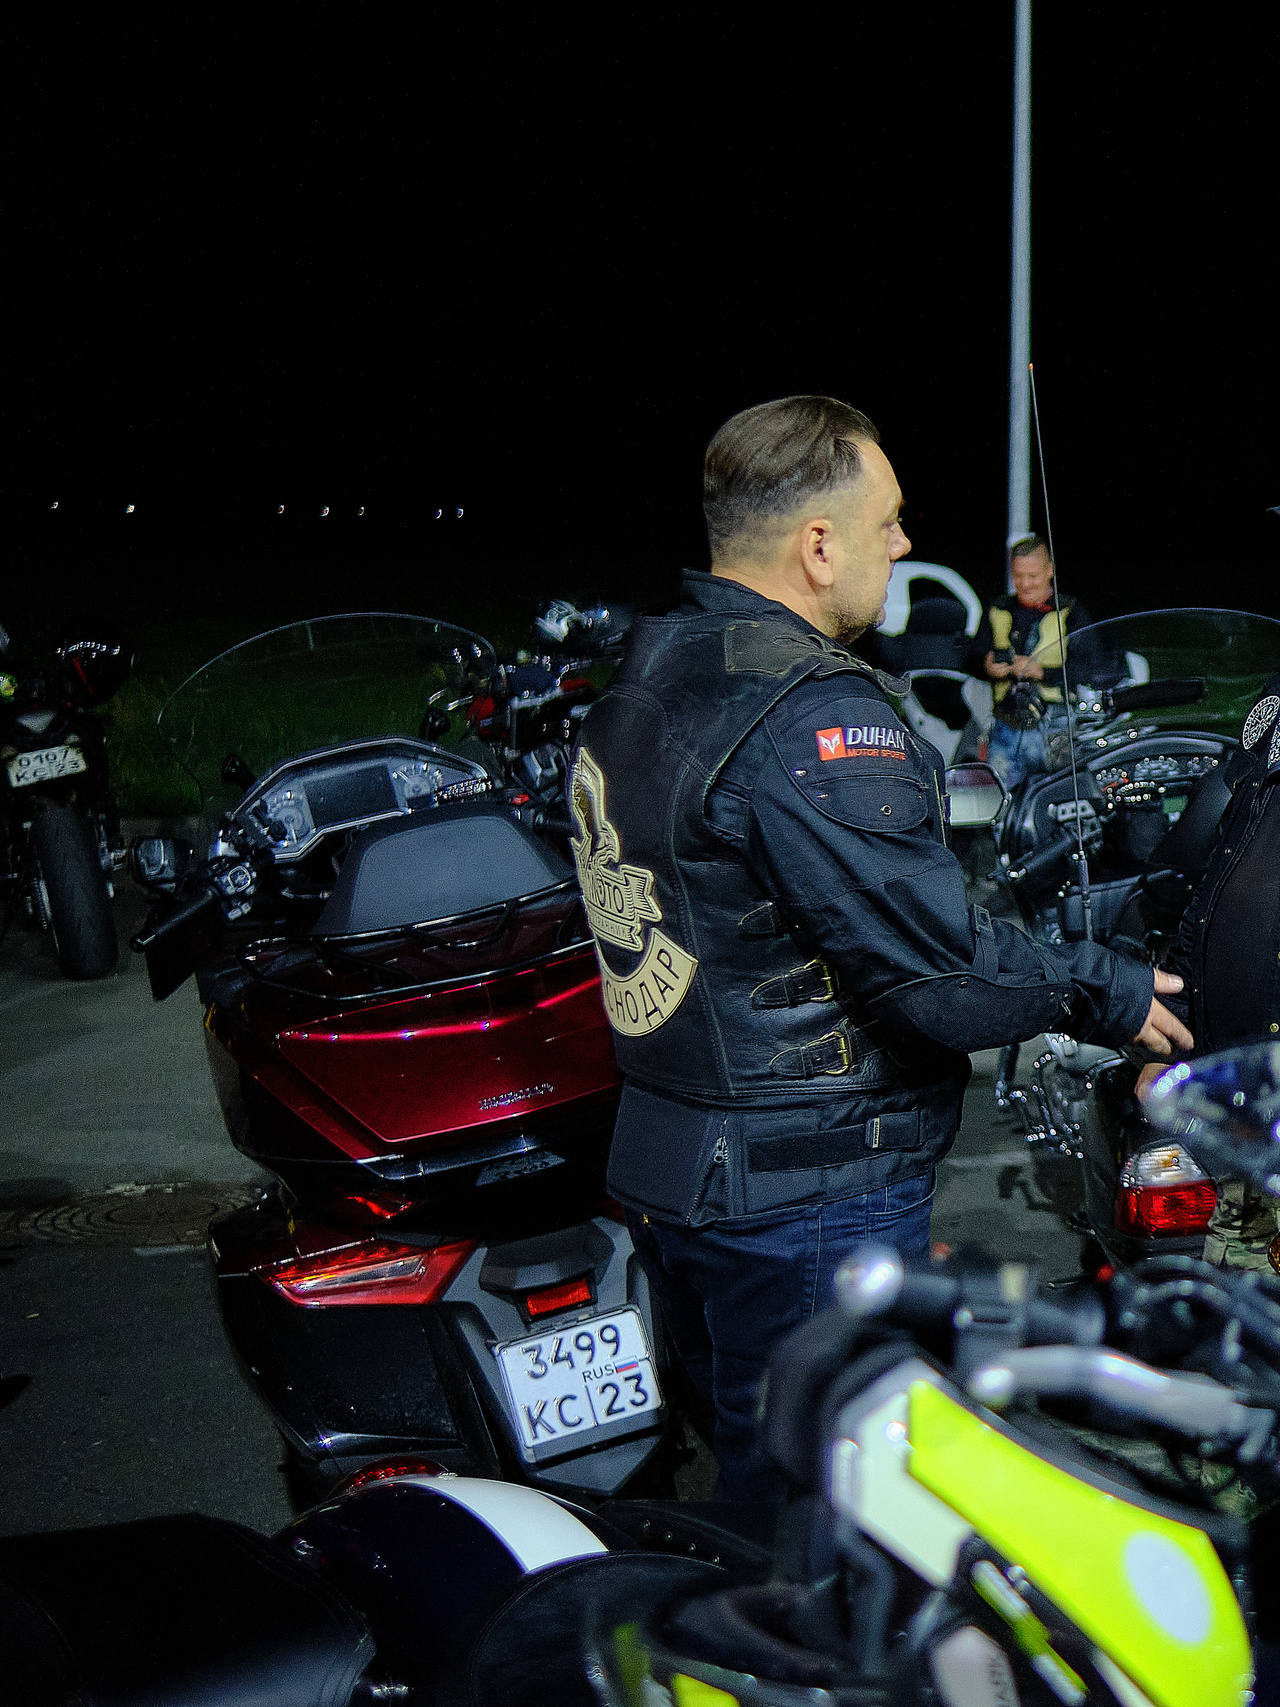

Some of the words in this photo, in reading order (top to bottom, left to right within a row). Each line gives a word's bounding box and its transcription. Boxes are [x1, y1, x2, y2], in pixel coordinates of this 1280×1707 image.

[846, 726, 905, 751] DUHAN
[847, 748, 879, 758] MOTOR
[604, 948, 680, 1028] СНОДАР
[519, 1324, 621, 1380] 3499
[582, 1363, 615, 1382] RUS
[598, 1372, 649, 1417] 23
